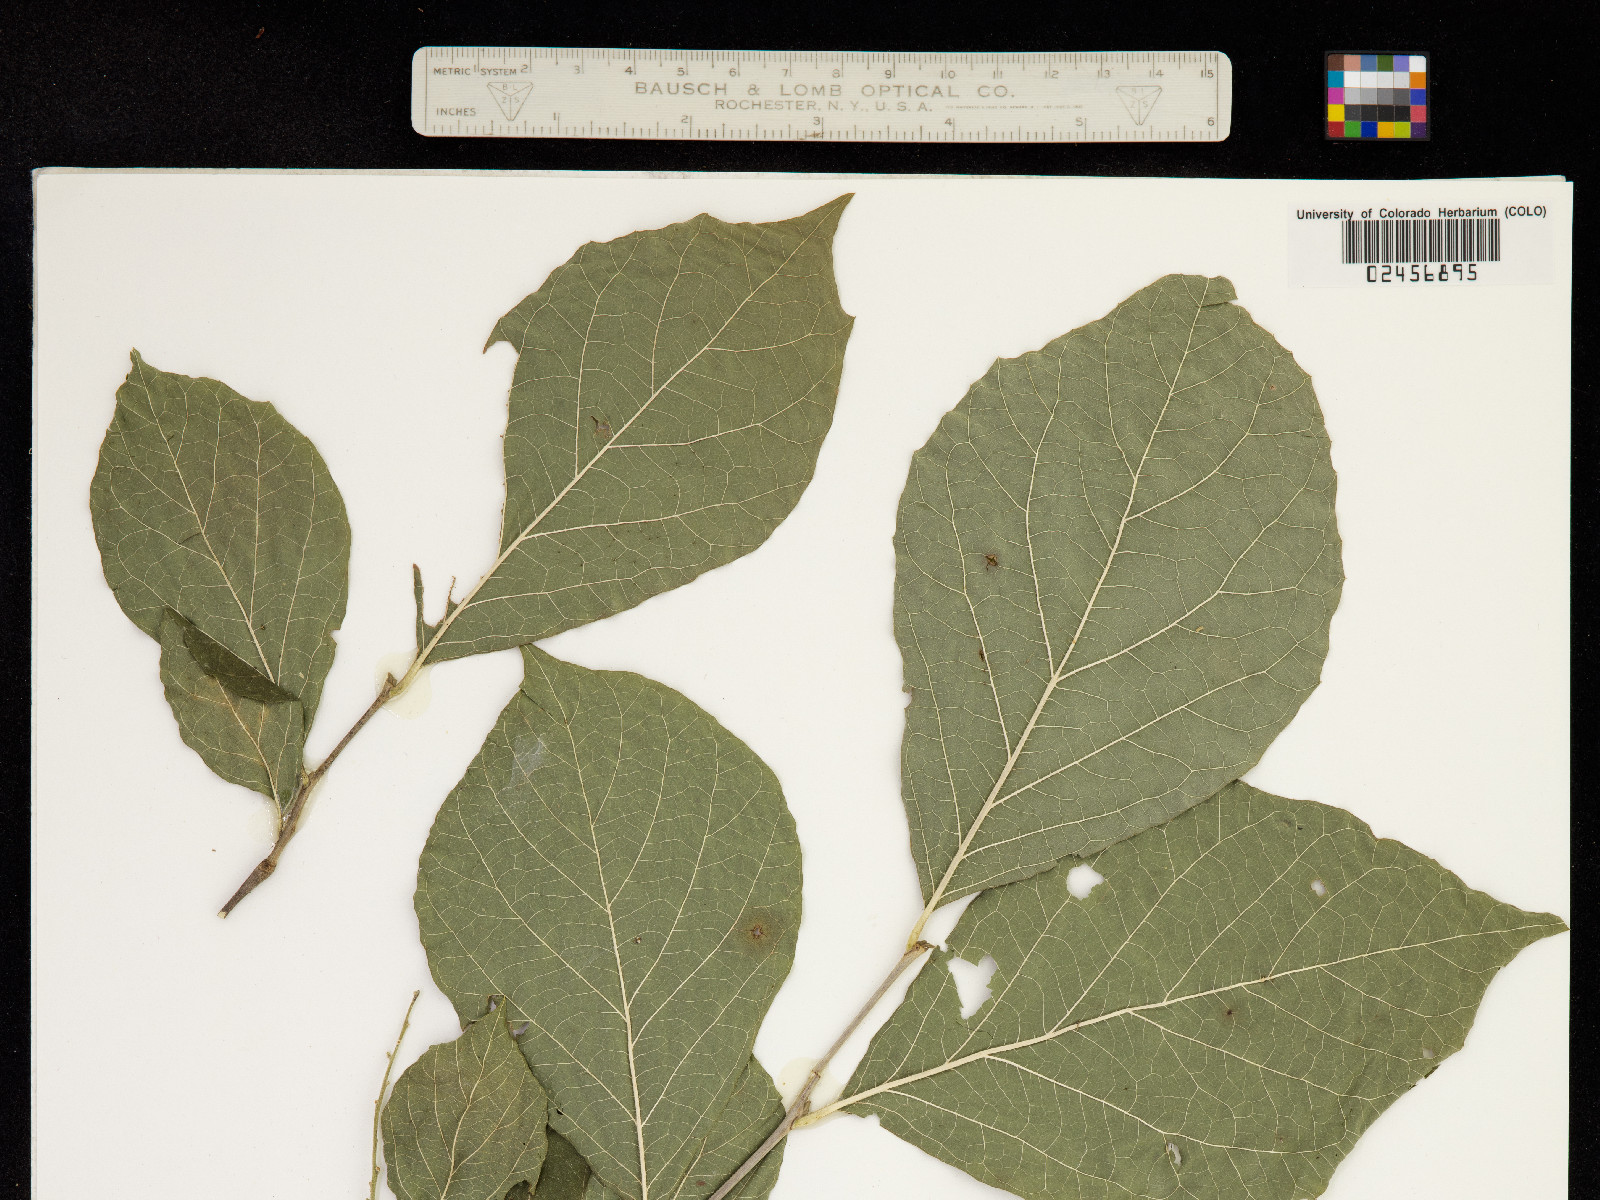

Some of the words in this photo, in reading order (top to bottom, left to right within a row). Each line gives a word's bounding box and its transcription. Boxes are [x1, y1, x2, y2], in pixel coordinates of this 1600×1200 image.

[433, 67, 471, 76] METRIC
[480, 67, 517, 76] SYSTEM
[520, 64, 529, 73] 2
[574, 65, 581, 74] 3
[624, 66, 634, 75] 4
[677, 67, 685, 76] 5
[729, 68, 737, 77] 6
[782, 68, 789, 77] 7
[885, 70, 892, 78] 9
[941, 70, 956, 79] 10
[1045, 70, 1059, 79] 12
[1098, 70, 1111, 79] 13
[1149, 70, 1164, 78] 14
[1201, 70, 1214, 79] 15
[635, 81, 728, 96] BAUSCH
[747, 83, 760, 96] &
[780, 84, 842, 97] LOMB
[861, 85, 960, 98] OPTICAL
[977, 86, 1015, 98] CO.
[436, 107, 476, 117] INCHES
[715, 99, 822, 112] ROCHESTER,
[681, 115, 689, 124] 2
[813, 116, 821, 125] 3
[944, 118, 952, 126] 4
[1207, 117, 1214, 127] 6
[1296, 208, 1354, 221] University
[1361, 207, 1372, 219] of
[1379, 207, 1431, 218] Colorado
[1438, 206, 1498, 218] Herbarium
[1504, 205, 1547, 219] (COLO)
[1366, 263, 1478, 283] 02456895
